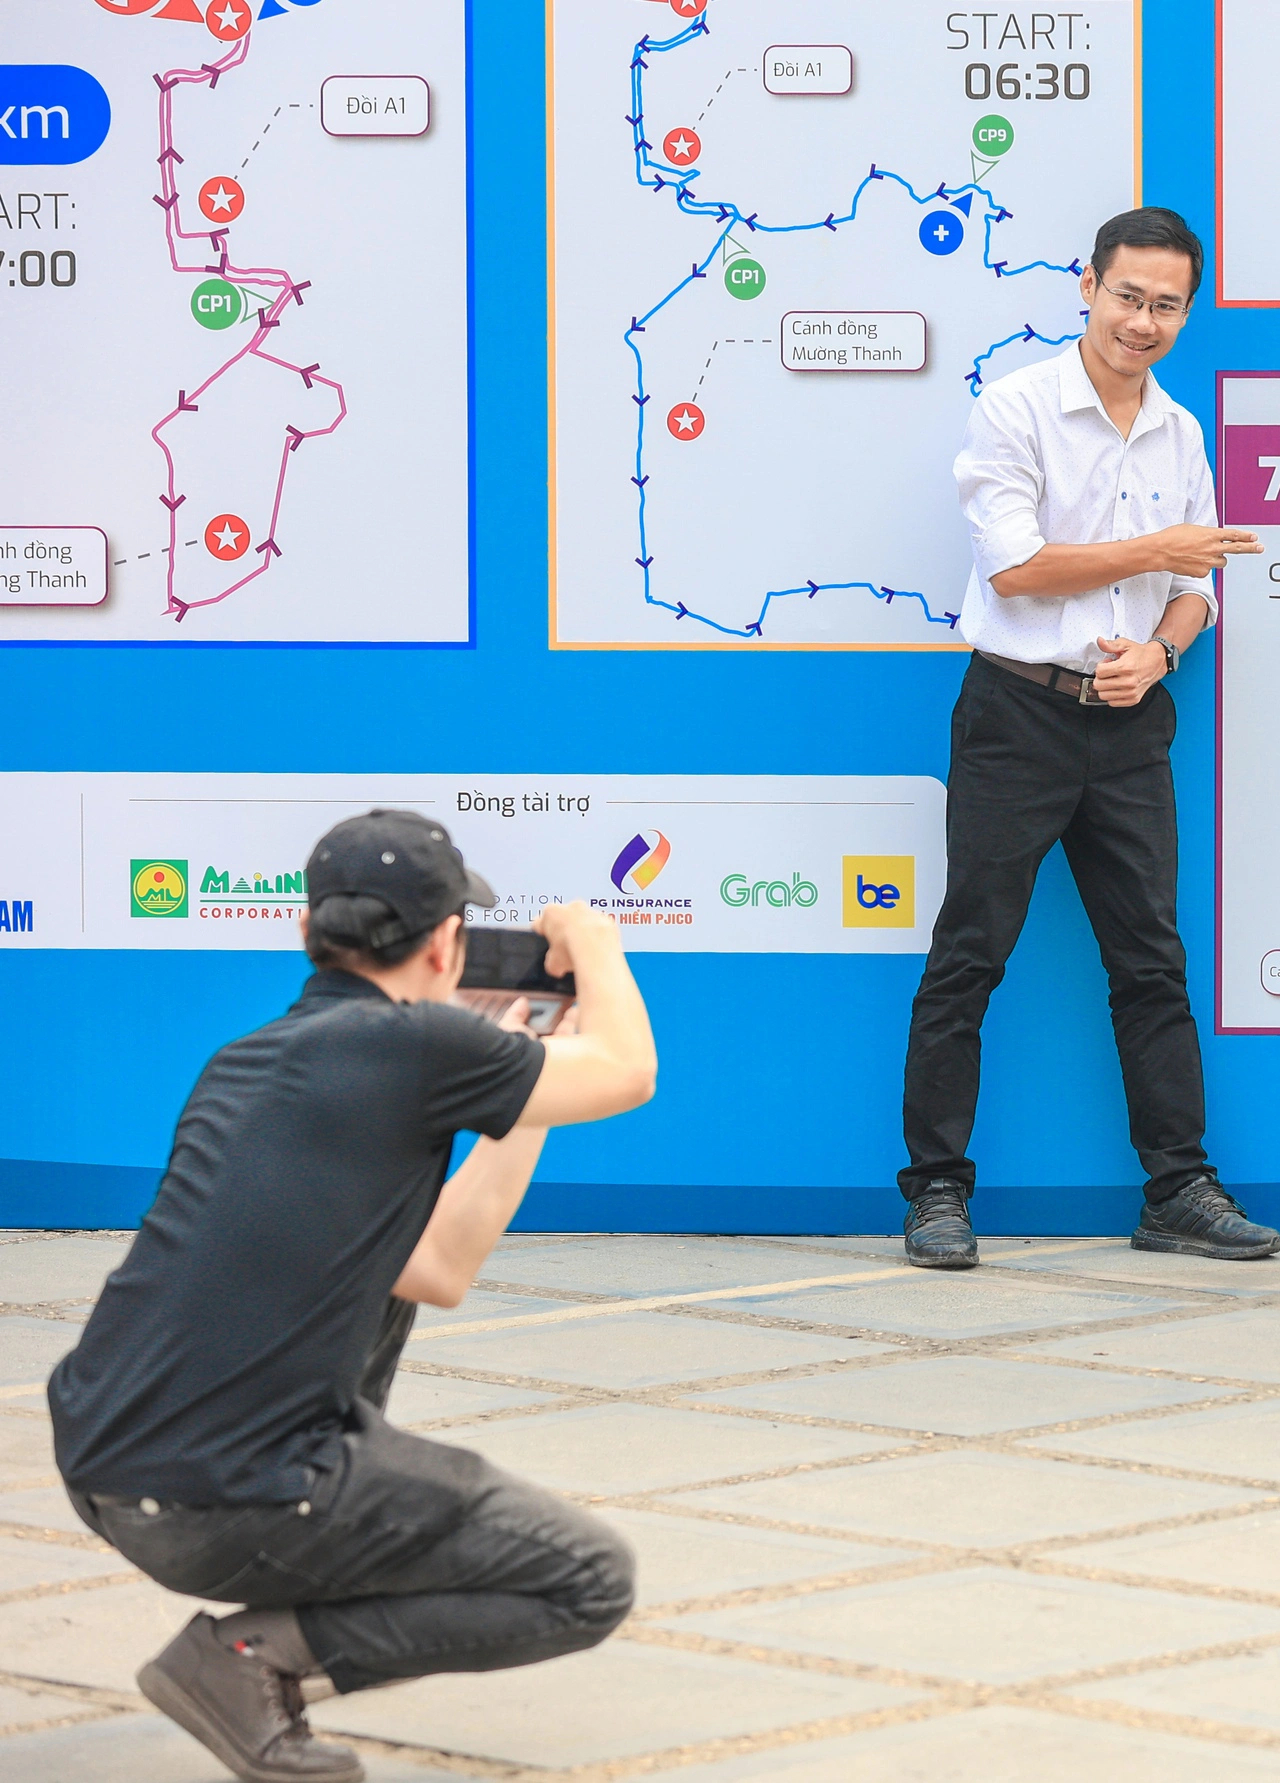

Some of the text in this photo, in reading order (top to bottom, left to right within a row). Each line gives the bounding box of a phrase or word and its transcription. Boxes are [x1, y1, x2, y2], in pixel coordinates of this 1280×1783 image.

[945, 12, 1091, 51] START:
[772, 59, 823, 78] Đồi A1
[963, 62, 1091, 101] 06:30
[345, 95, 407, 116] Đồi A1
[977, 127, 1008, 143] CP9
[0, 249, 77, 288] :00
[730, 268, 760, 285] CP1
[196, 294, 233, 314] CP1
[791, 316, 878, 341] Cánh đồng
[792, 342, 903, 364] Mường Thanh
[23, 539, 73, 564] đồng
[26, 570, 87, 588] Thanh
[456, 790, 591, 818] Đồng tài trợ
[719, 871, 819, 909] Grab
[856, 874, 900, 909] be
[590, 898, 692, 908] PG INSURANCE
[483, 909, 519, 922] FOR
[620, 909, 652, 924] HIỂM
[656, 913, 693, 925] PJICO
